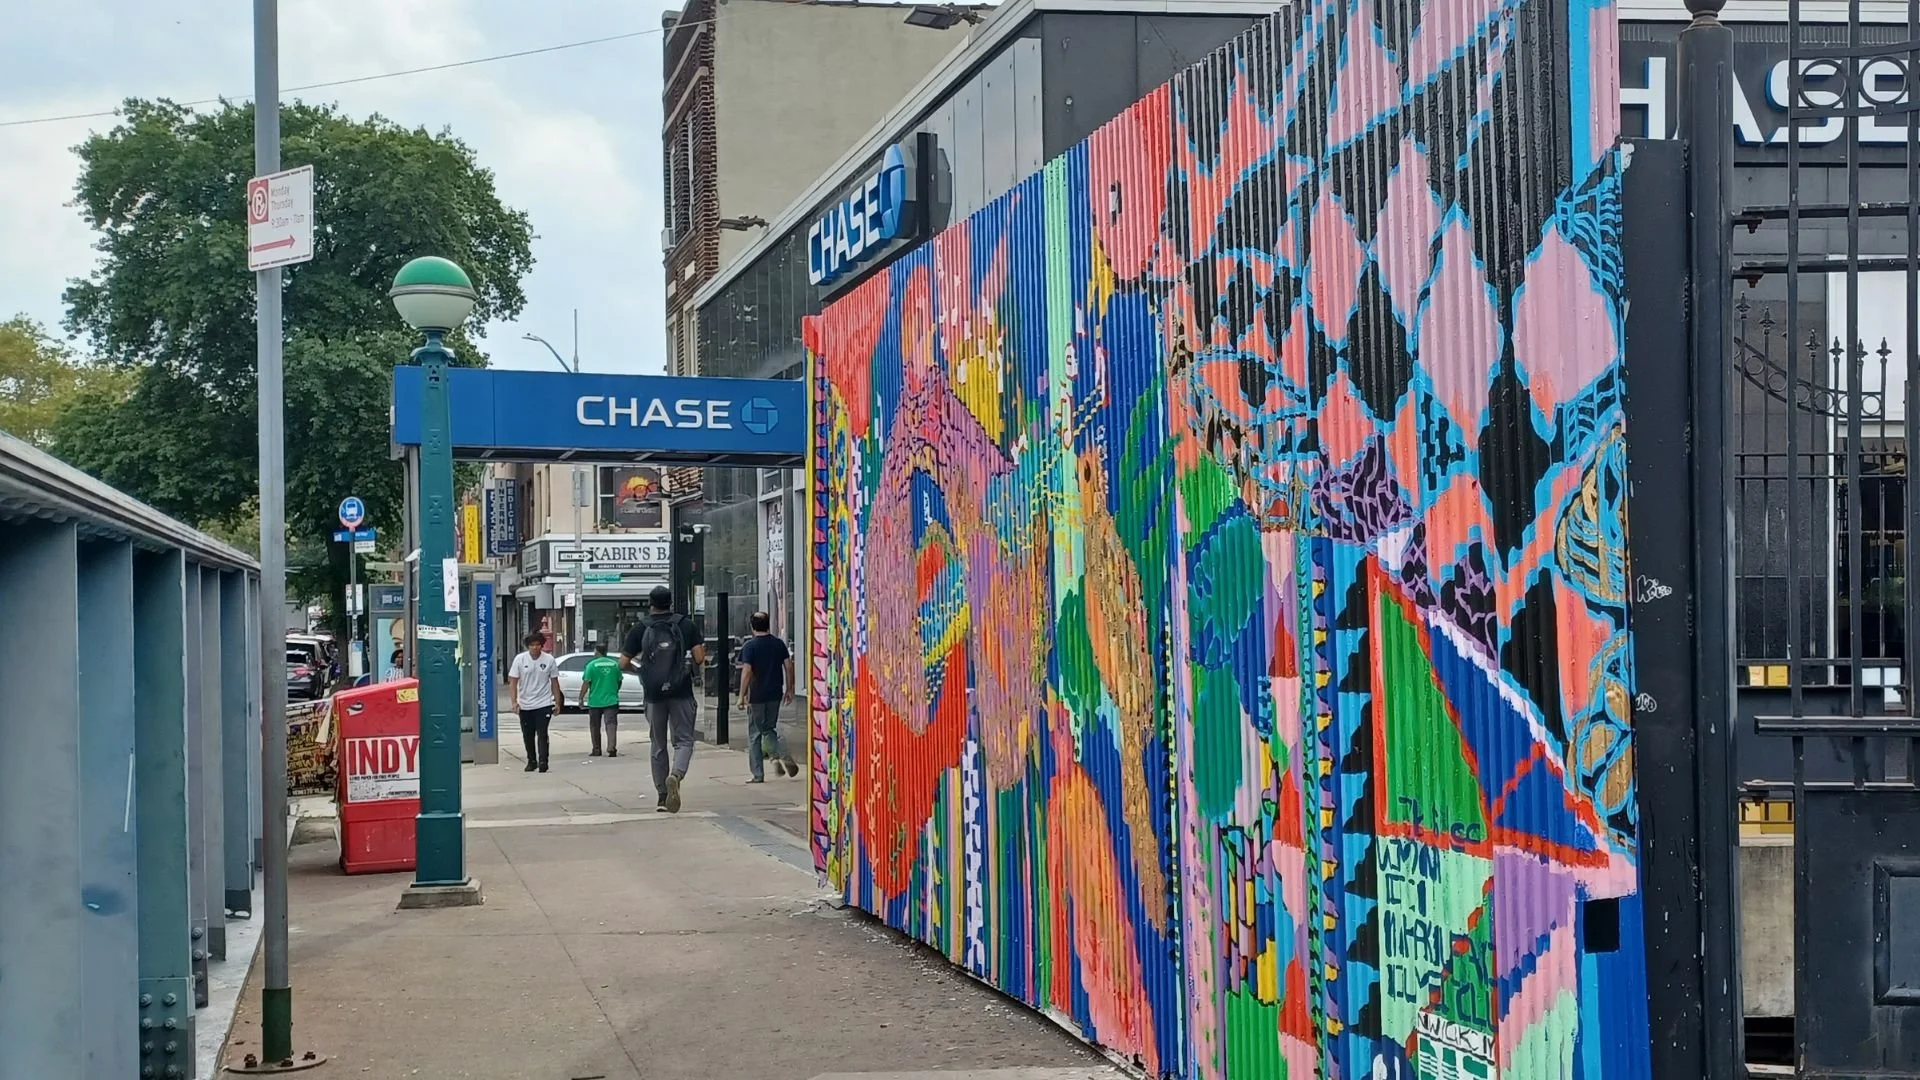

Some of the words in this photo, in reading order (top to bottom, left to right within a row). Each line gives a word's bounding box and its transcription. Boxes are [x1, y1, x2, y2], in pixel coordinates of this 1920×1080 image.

[271, 198, 294, 210] Thursday
[807, 173, 880, 285] CHASE
[576, 396, 733, 429] CHASE
[589, 547, 651, 561] KABIR'S
[478, 595, 487, 621] Foster
[479, 621, 487, 649] Avenue
[479, 650, 487, 659] &
[478, 660, 488, 710] Marlborough
[479, 711, 488, 733] Road
[348, 738, 420, 776] INDY
